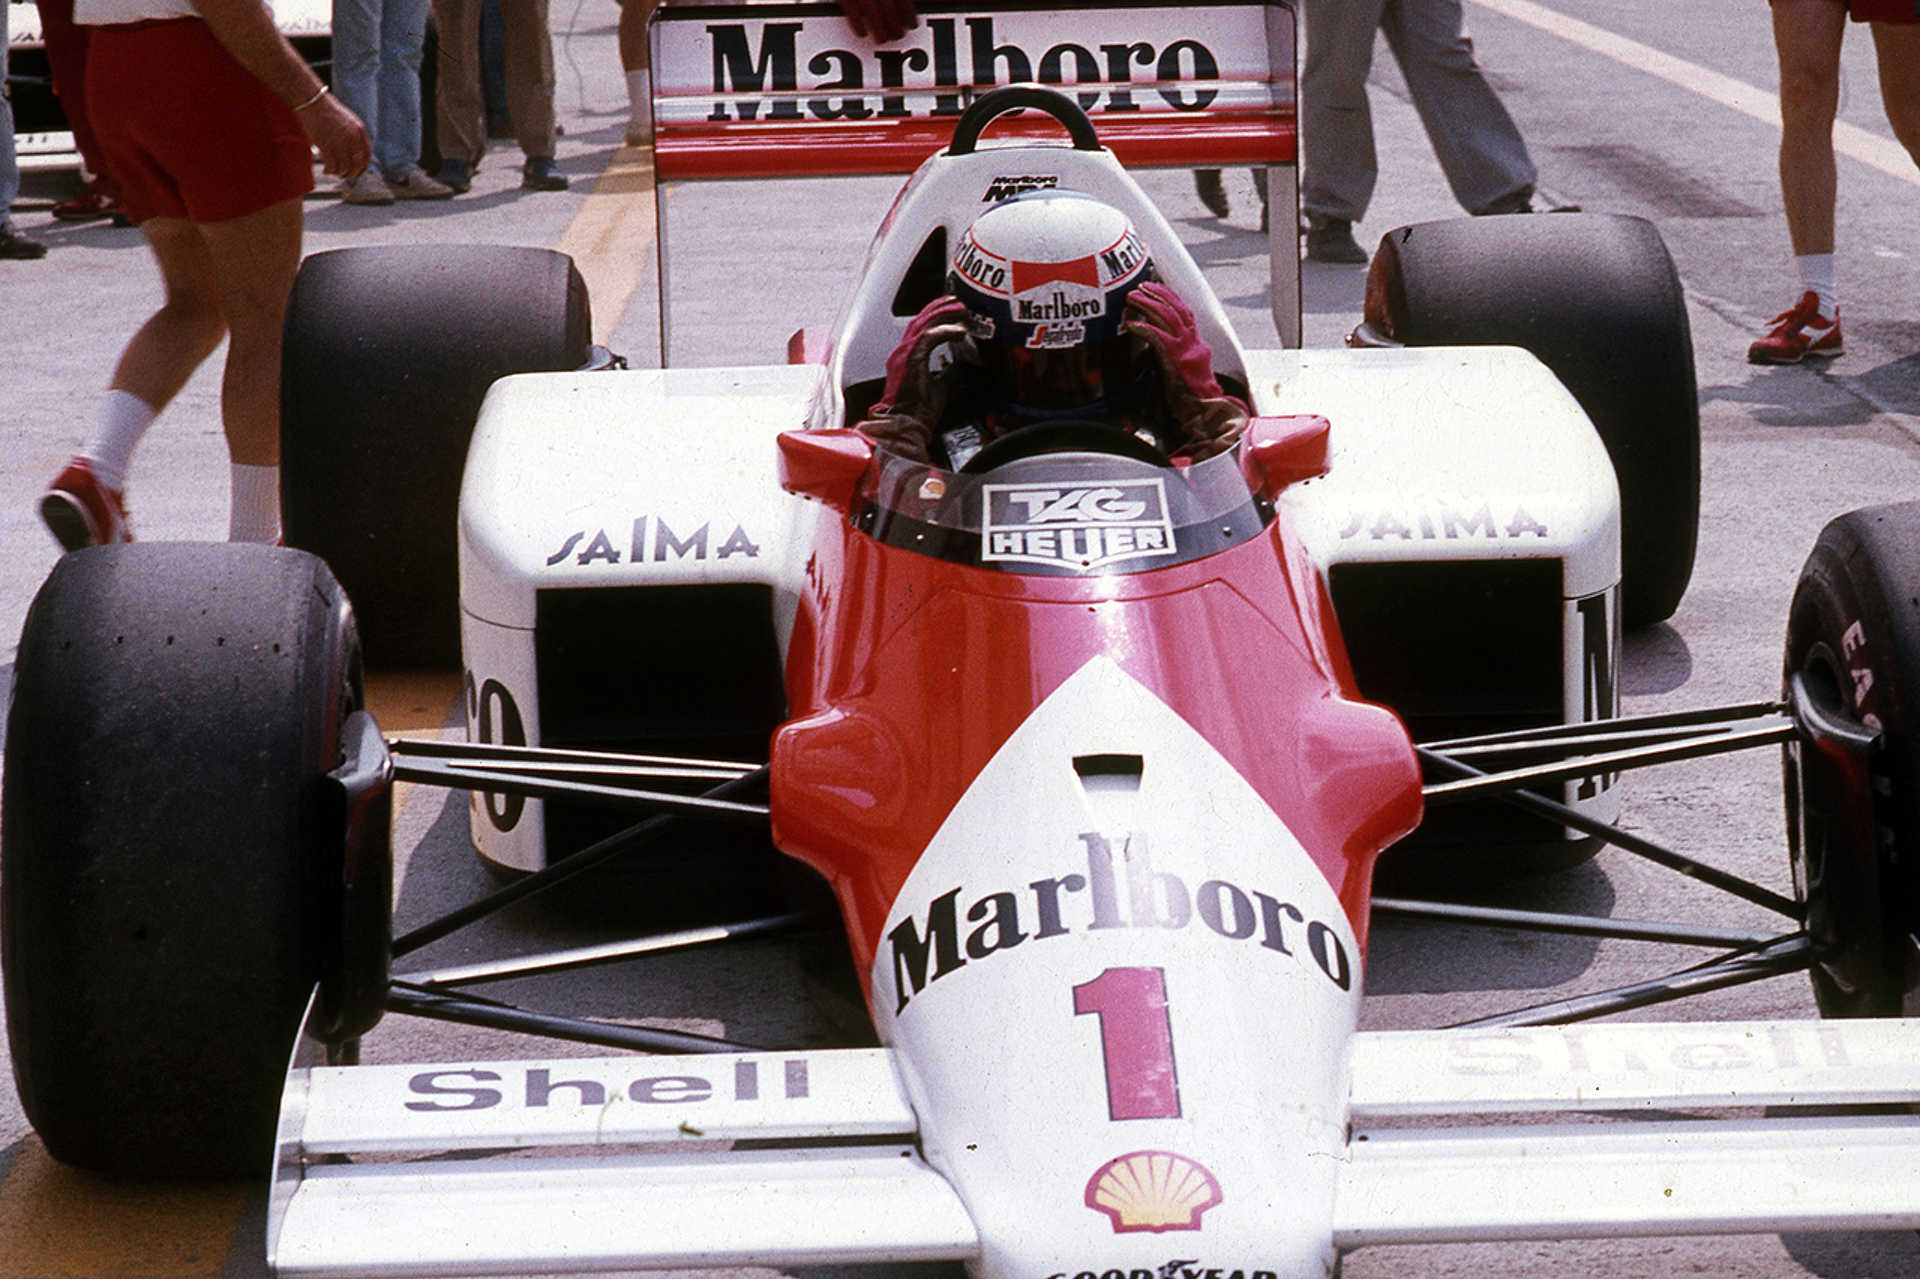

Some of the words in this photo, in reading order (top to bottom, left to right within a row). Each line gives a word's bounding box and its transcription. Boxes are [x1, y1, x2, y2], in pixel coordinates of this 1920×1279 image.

[705, 17, 1219, 122] Marlboro
[991, 175, 1058, 185] Marlboro
[1018, 292, 1100, 321] Marlboro
[1009, 487, 1147, 524] TAG
[547, 514, 760, 567] SAIMA
[993, 527, 1168, 564] HEUER
[888, 831, 1351, 1017] Marlboro
[1071, 966, 1183, 1122] 1
[404, 1058, 809, 1113] Shell
